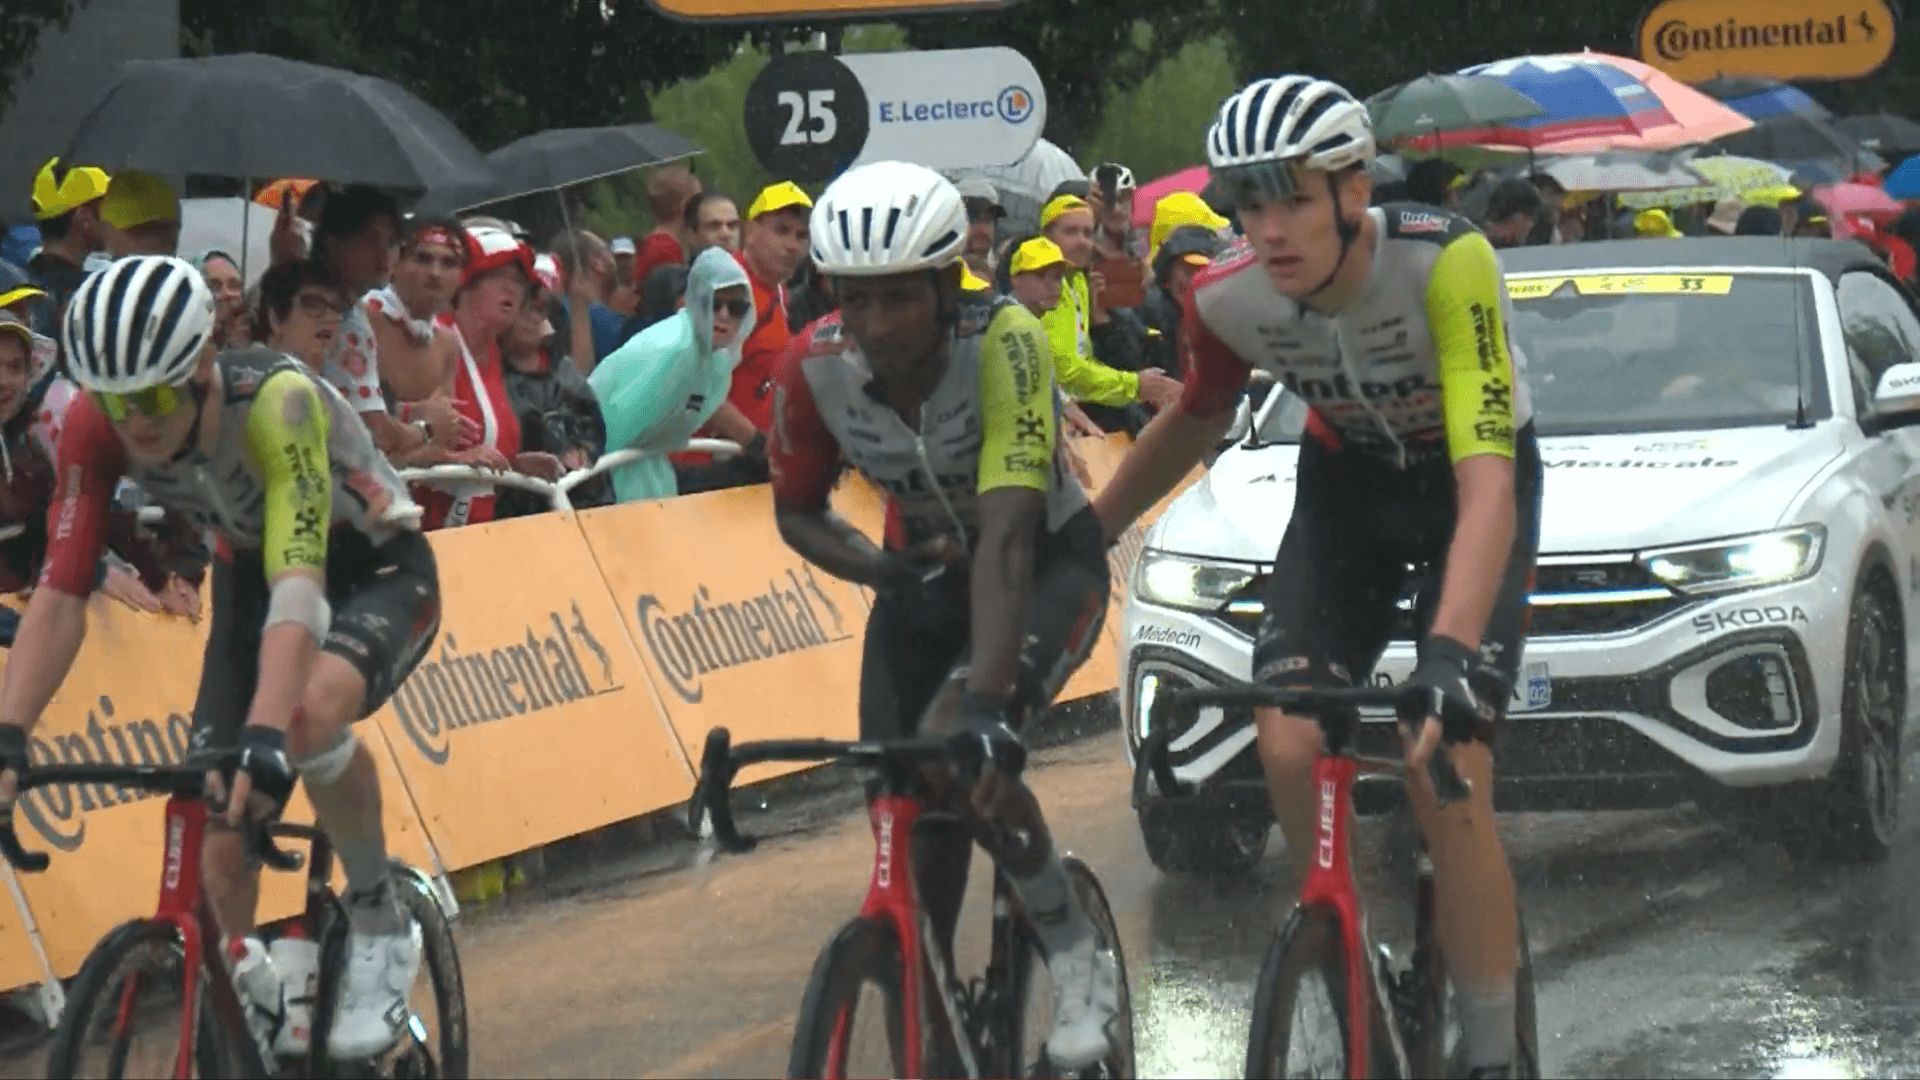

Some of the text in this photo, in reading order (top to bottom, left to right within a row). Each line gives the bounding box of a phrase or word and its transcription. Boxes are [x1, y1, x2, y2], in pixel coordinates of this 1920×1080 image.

[1654, 14, 1847, 62] Continental
[777, 88, 837, 146] 25
[879, 99, 994, 123] E.Leclerc
[637, 568, 829, 704] Continental
[392, 611, 595, 766] Continental
[166, 814, 186, 889] CUBE
[879, 812, 893, 888] CUBE
[1319, 781, 1335, 868] CUBE
